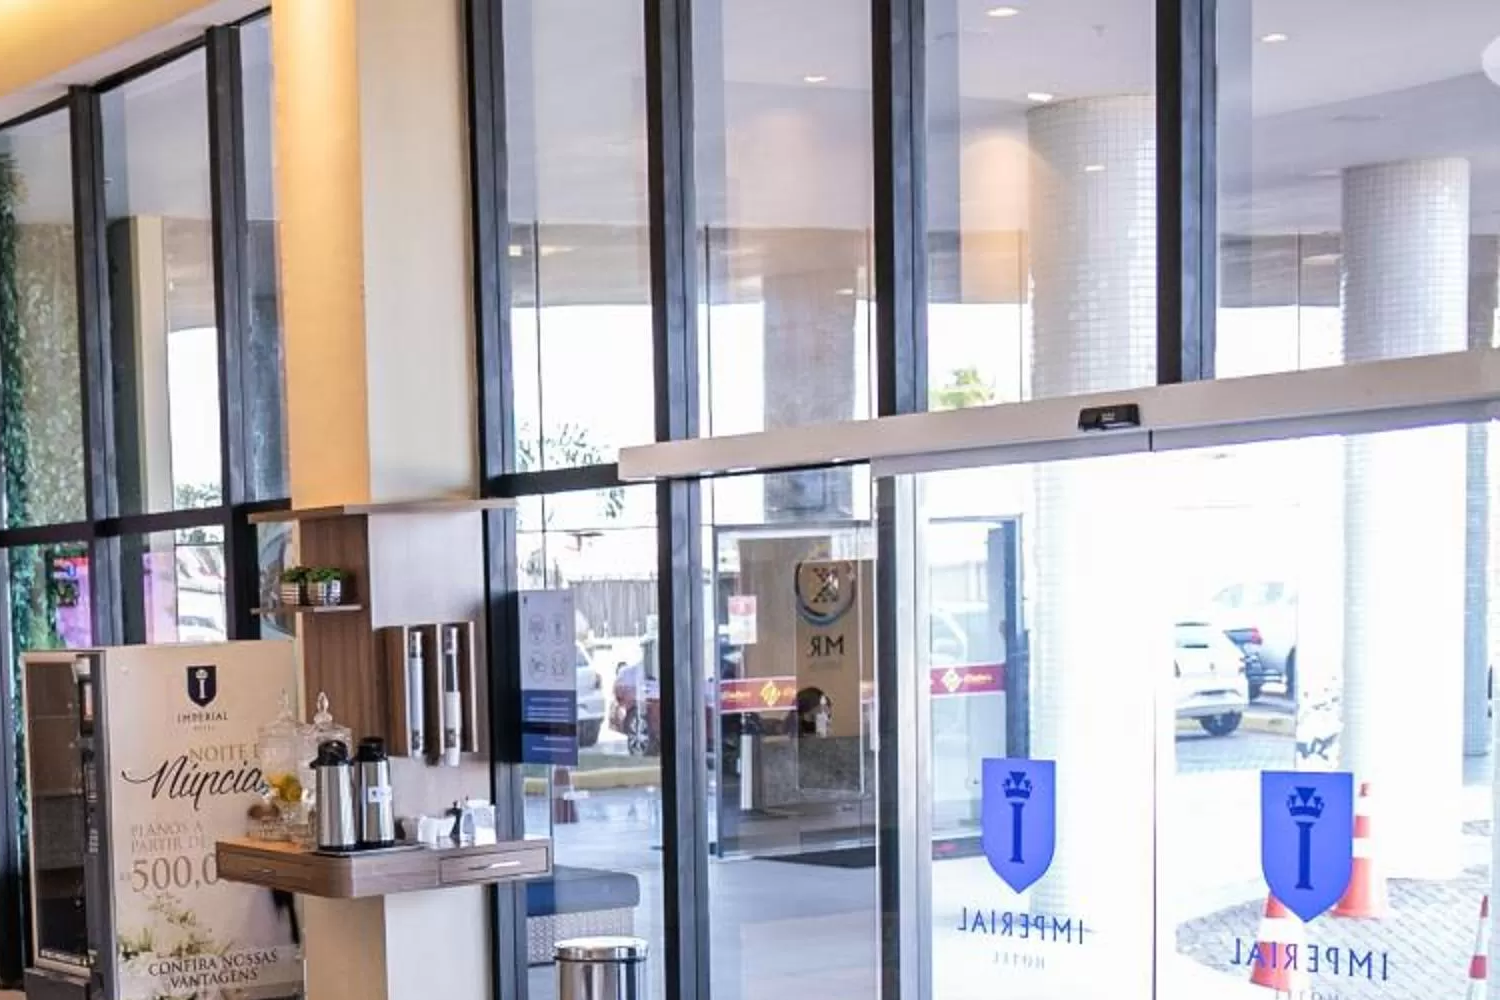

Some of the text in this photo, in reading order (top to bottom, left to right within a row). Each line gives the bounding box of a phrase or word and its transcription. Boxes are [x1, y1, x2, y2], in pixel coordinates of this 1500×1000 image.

[121, 755, 267, 812] Núpcia
[130, 852, 218, 893] 500,0
[148, 957, 219, 976] CONFIRA
[170, 968, 258, 989] VANTAGENS
